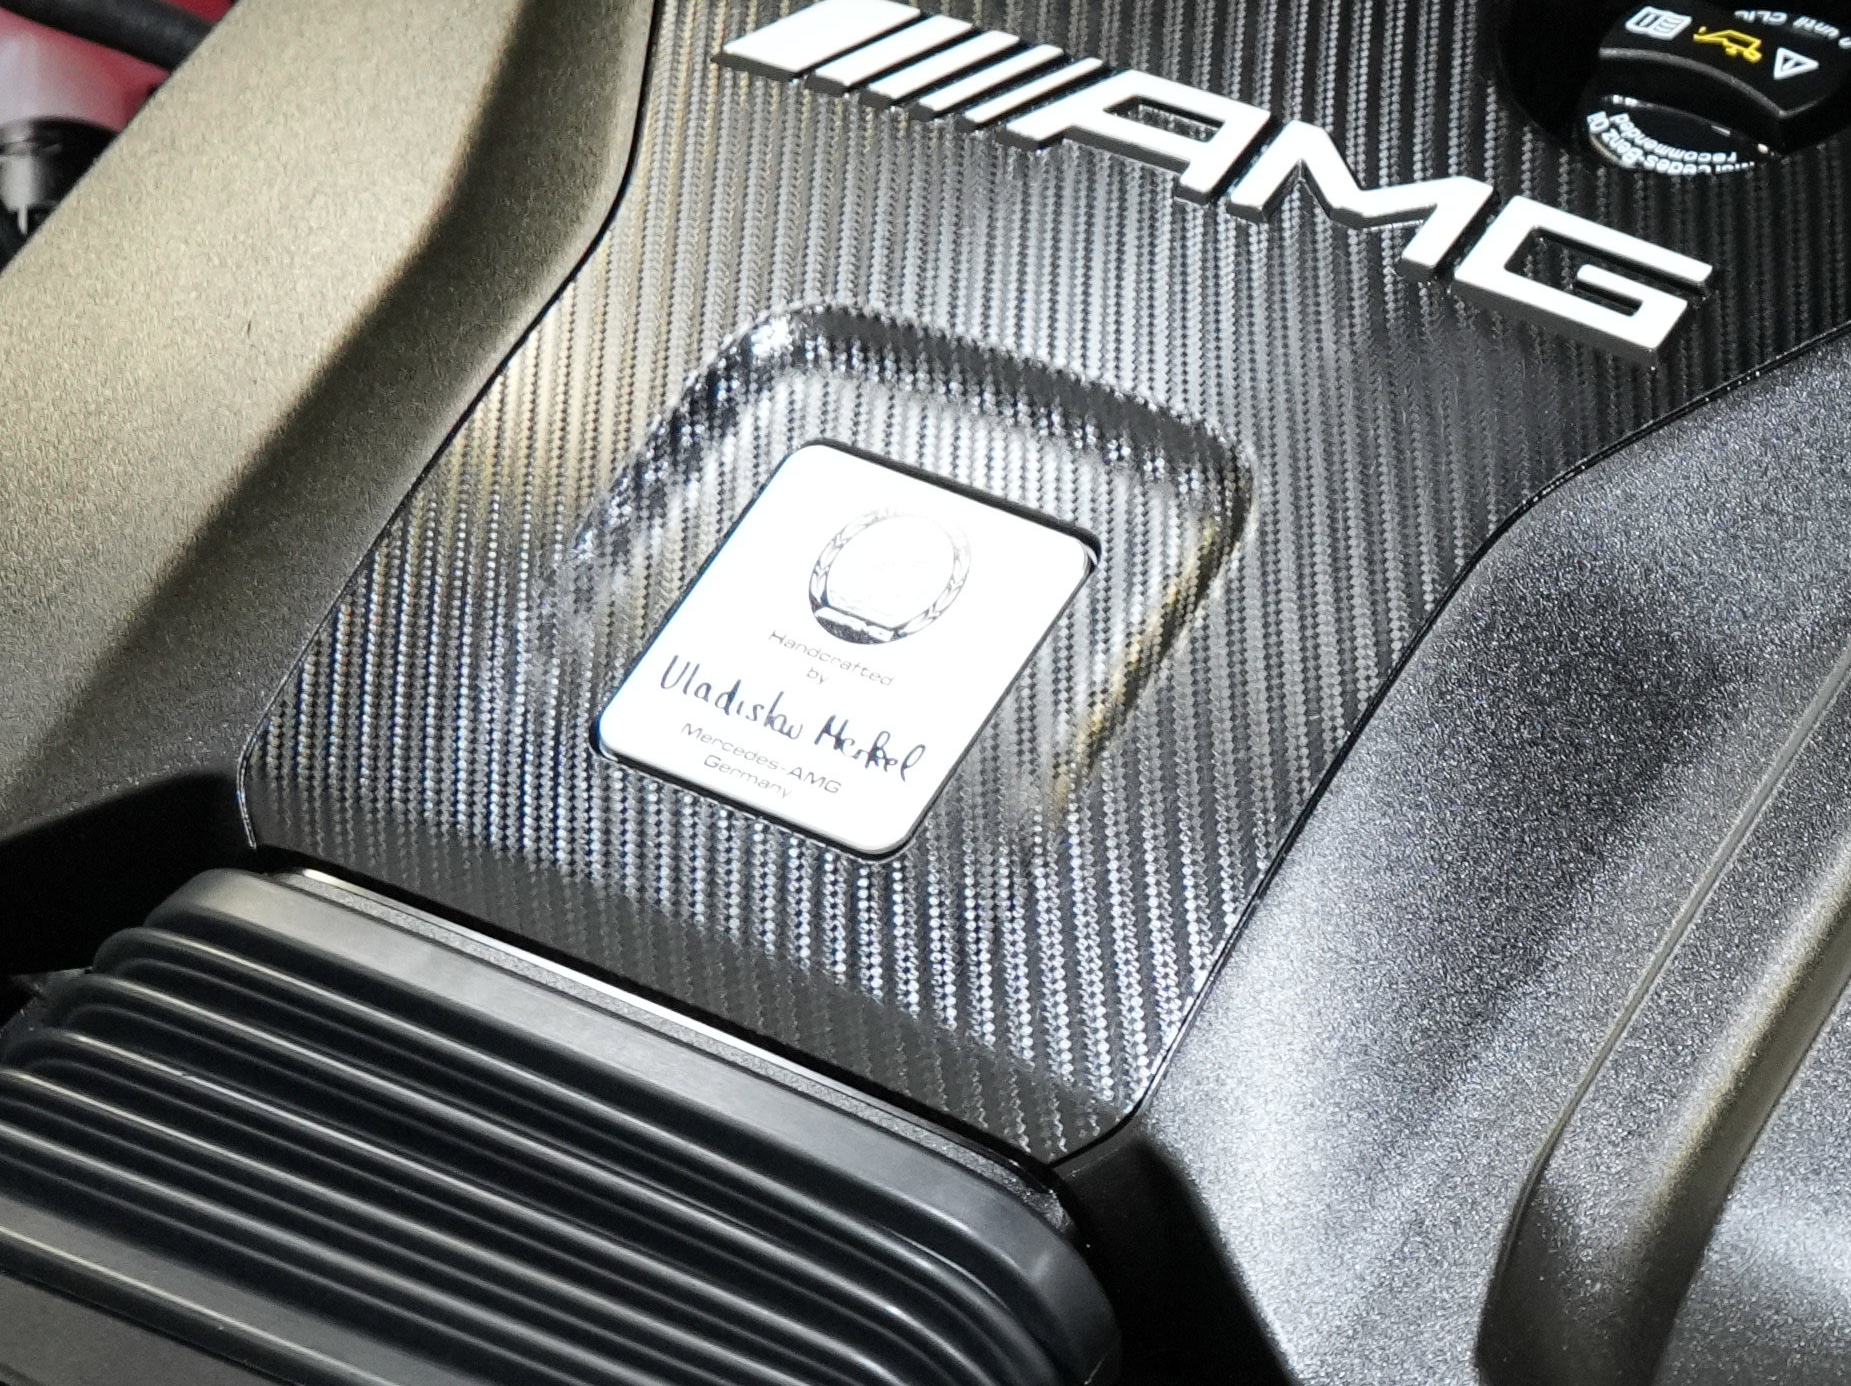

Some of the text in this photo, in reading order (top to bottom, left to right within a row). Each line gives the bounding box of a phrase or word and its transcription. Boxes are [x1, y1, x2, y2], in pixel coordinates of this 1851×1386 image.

[1793, 14, 1841, 40] until
[1609, 112, 1738, 164] recommended
[768, 629, 896, 688] Handcrafted
[805, 665, 830, 686] by
[680, 721, 843, 796] Mercedes-AMG
[702, 753, 794, 800] Germany
